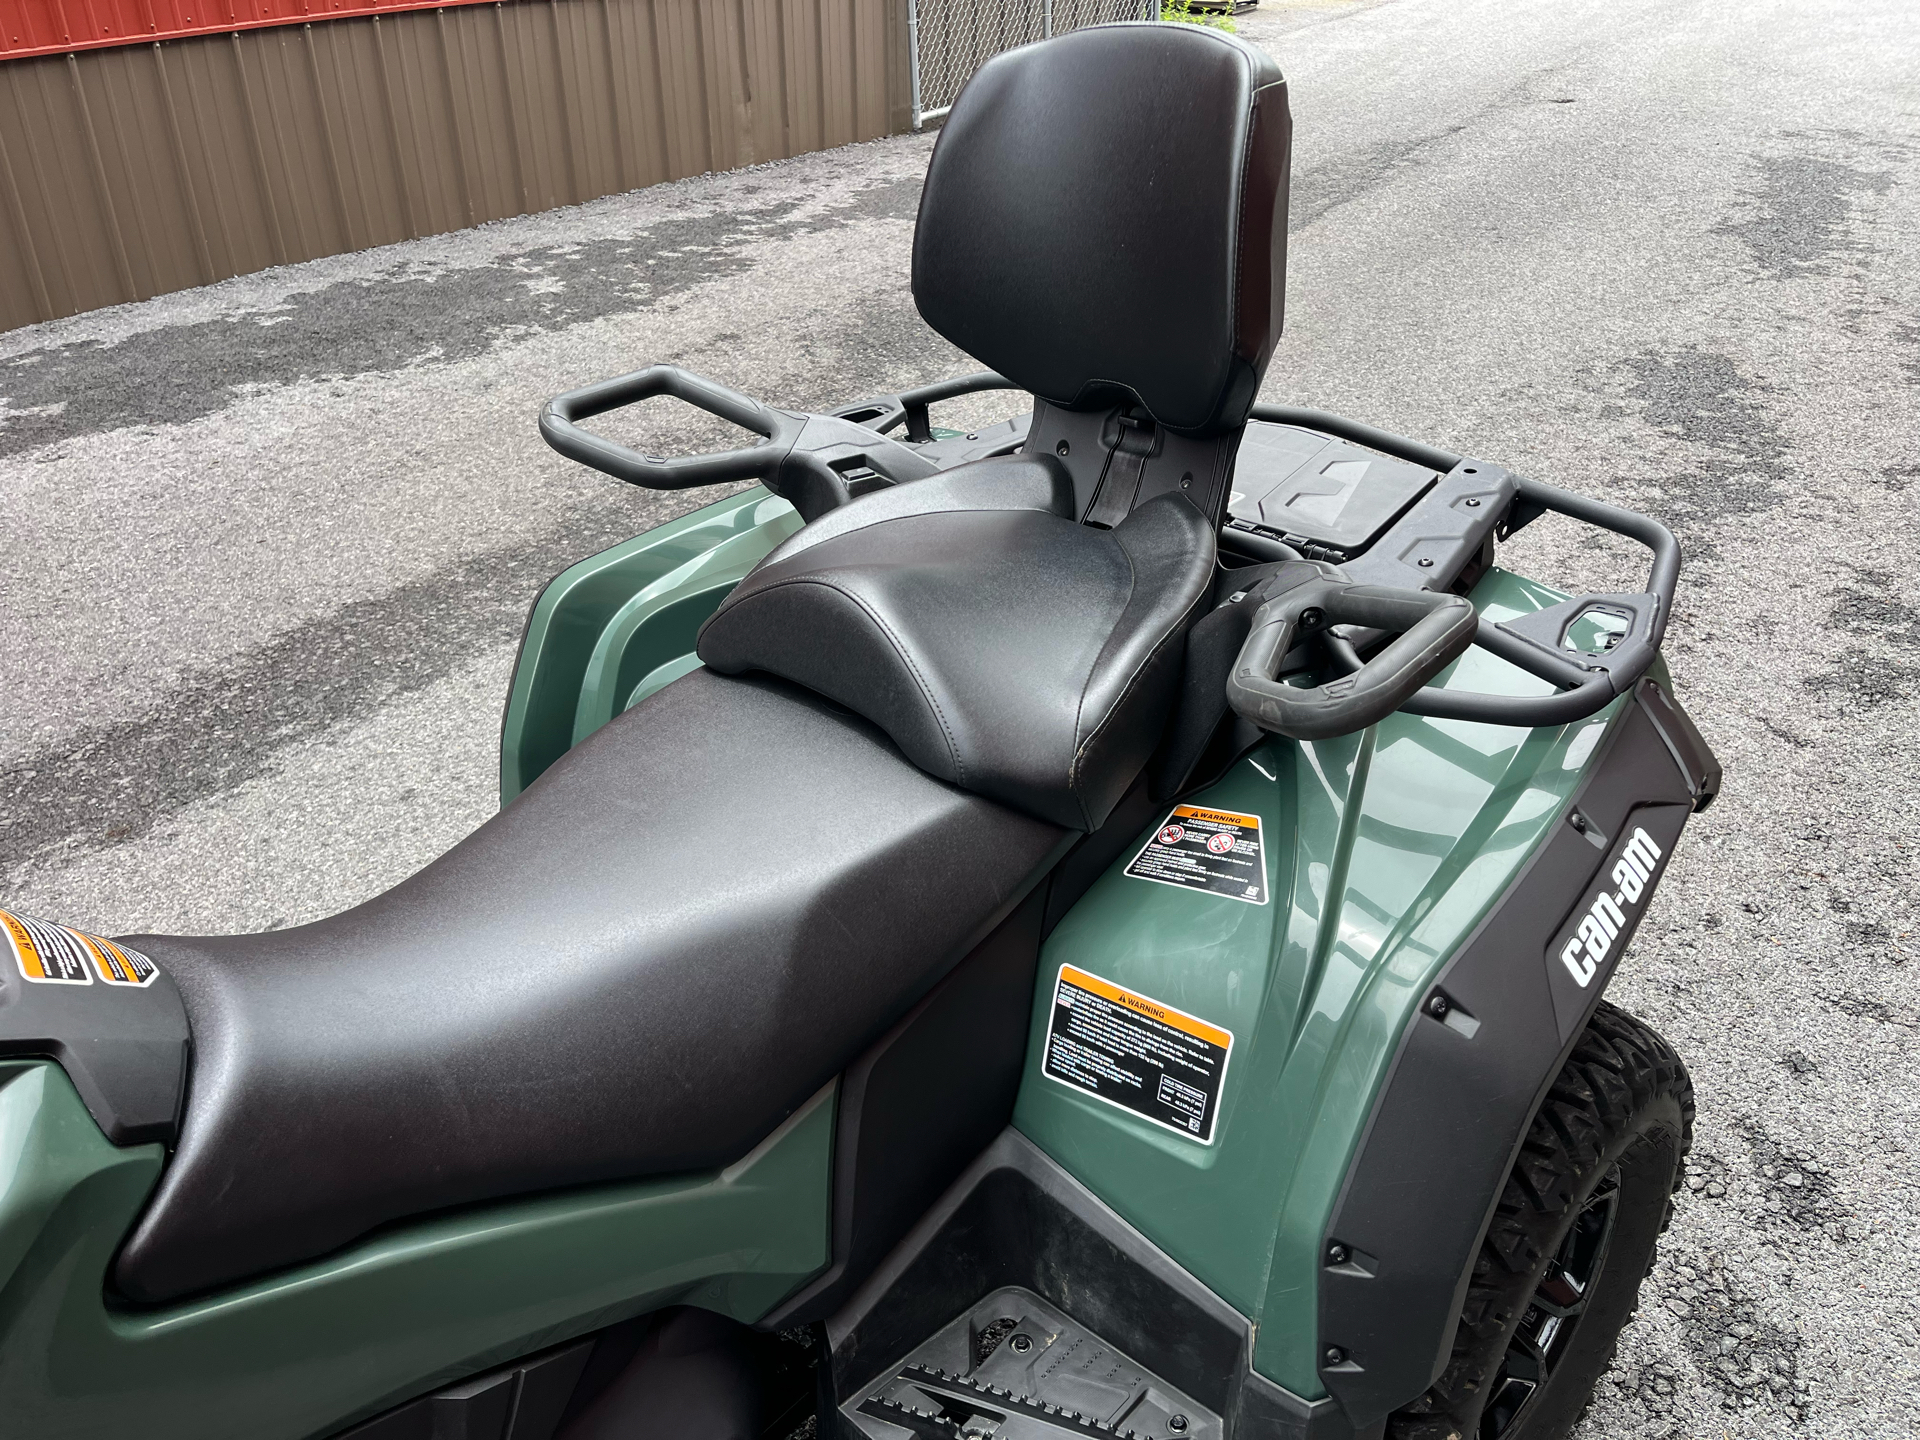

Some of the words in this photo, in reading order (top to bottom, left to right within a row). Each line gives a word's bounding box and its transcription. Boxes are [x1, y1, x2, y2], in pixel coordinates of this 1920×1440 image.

[1186, 818, 1218, 828] PASSENGER
[1217, 823, 1239, 832] SAFETY
[1199, 812, 1241, 824] WARNING
[1562, 827, 1662, 988] can-am
[1127, 997, 1165, 1019] WARNING
